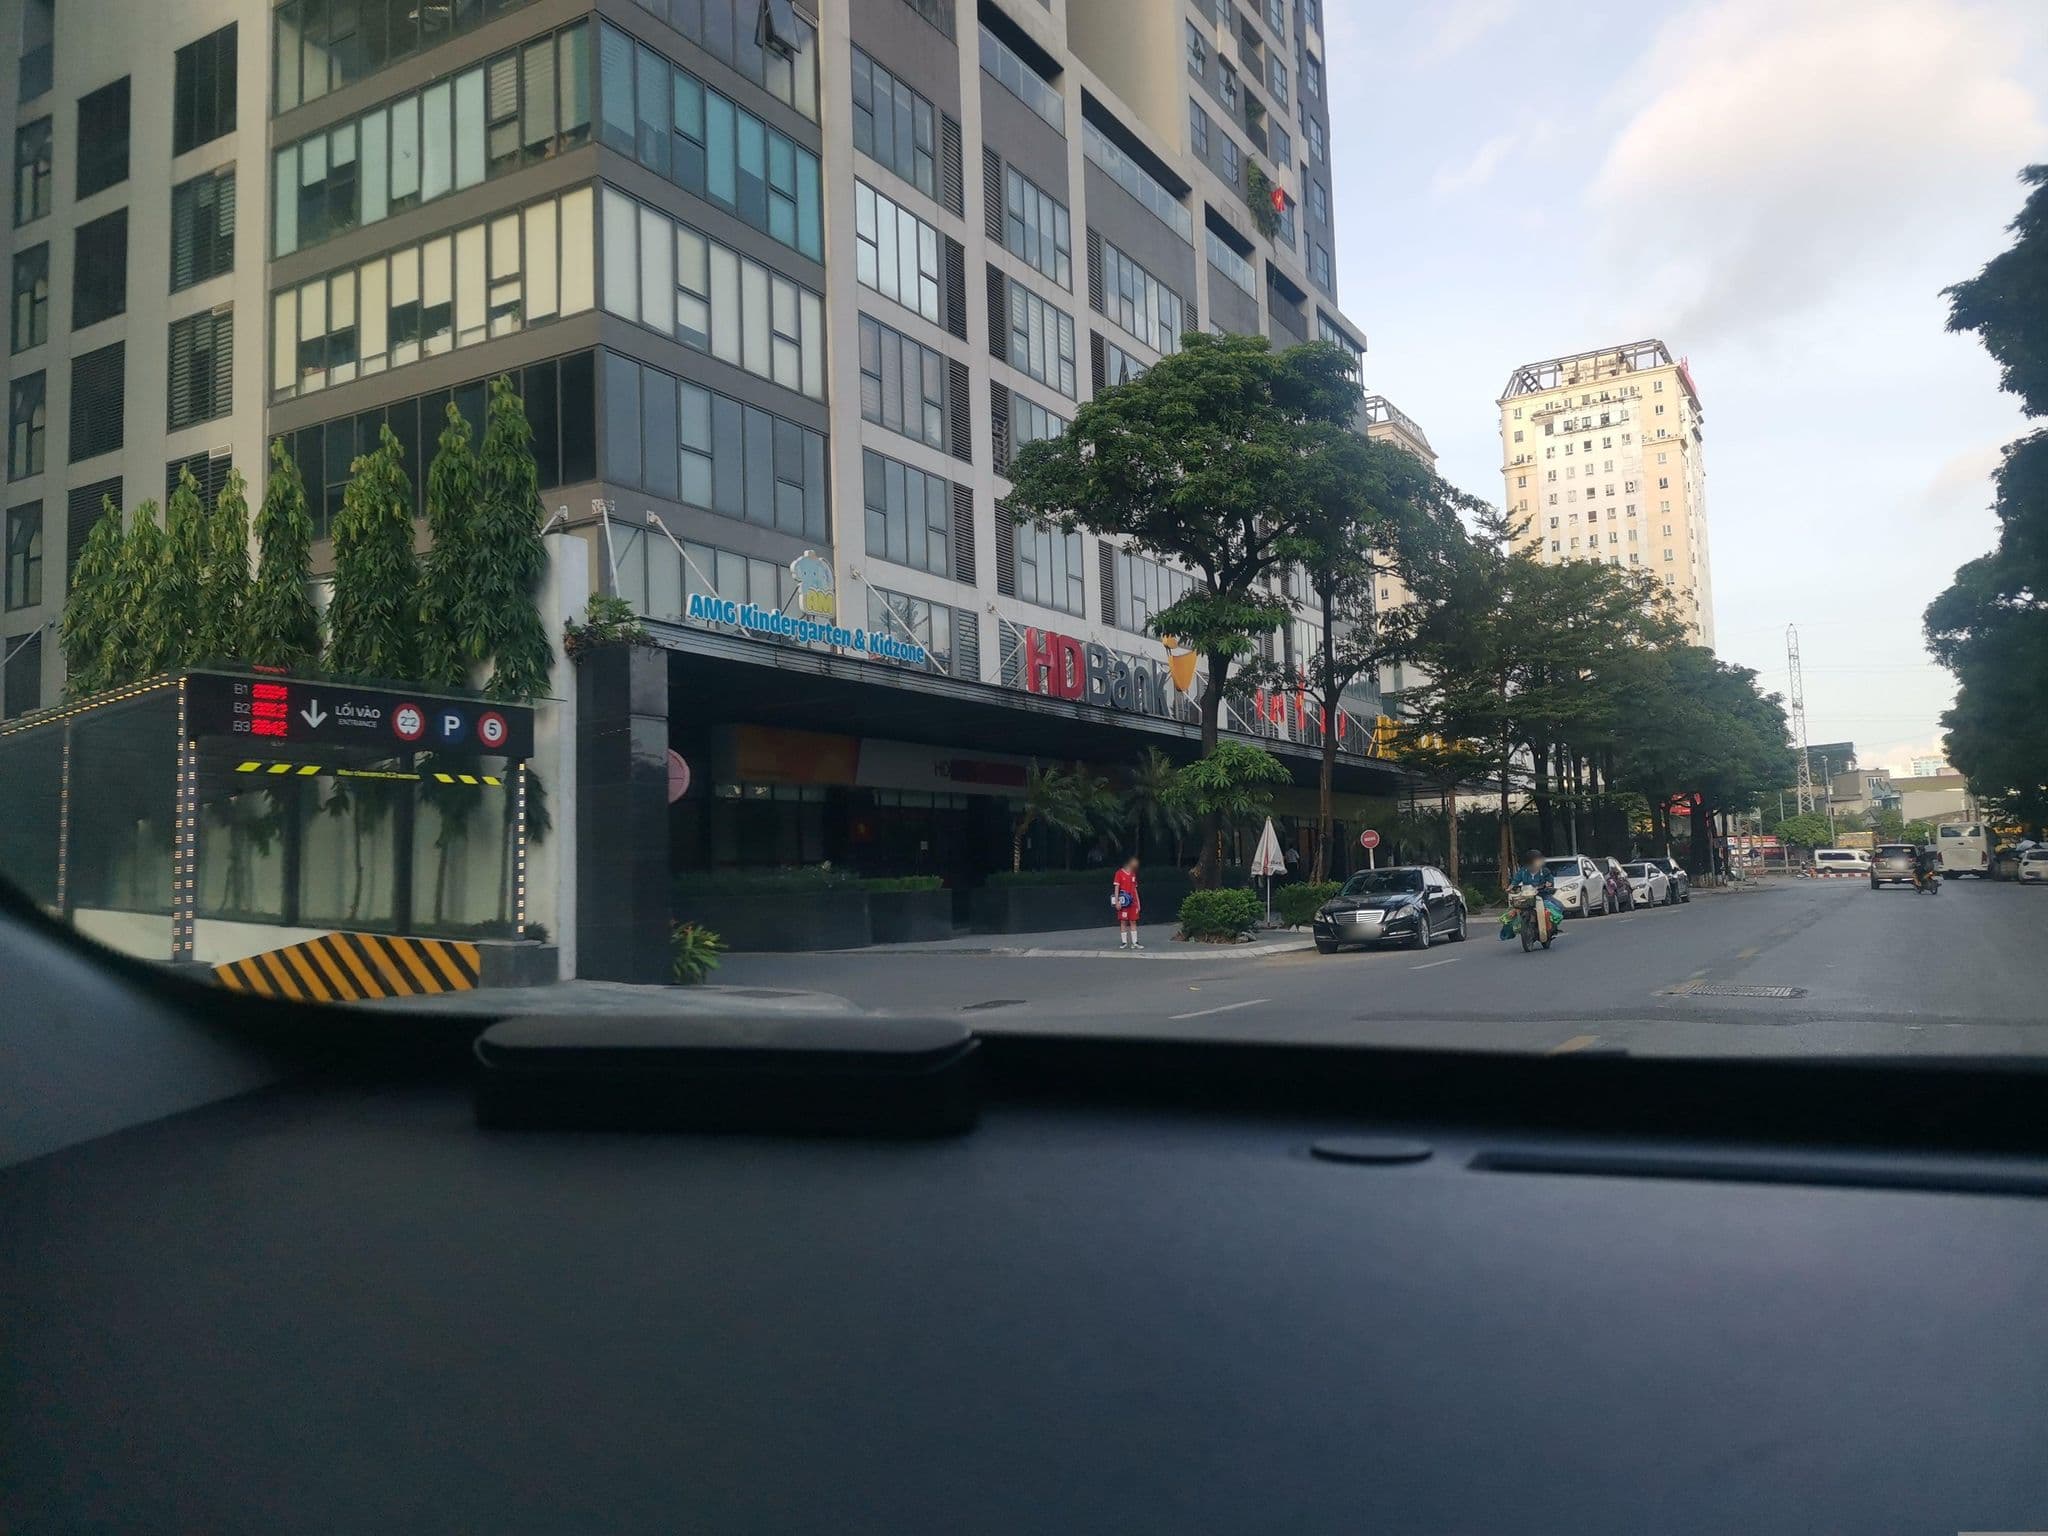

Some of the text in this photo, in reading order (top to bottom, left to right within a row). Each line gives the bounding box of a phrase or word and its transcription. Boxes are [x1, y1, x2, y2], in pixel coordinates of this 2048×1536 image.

[688, 593, 926, 664] AMG Kindergarten & Kidzone
[1025, 627, 1174, 718] HDBank
[233, 702, 251, 714] B2
[355, 705, 381, 719] VÀO
[232, 720, 251, 732] B3
[444, 715, 461, 736] P
[488, 722, 498, 737] 5
